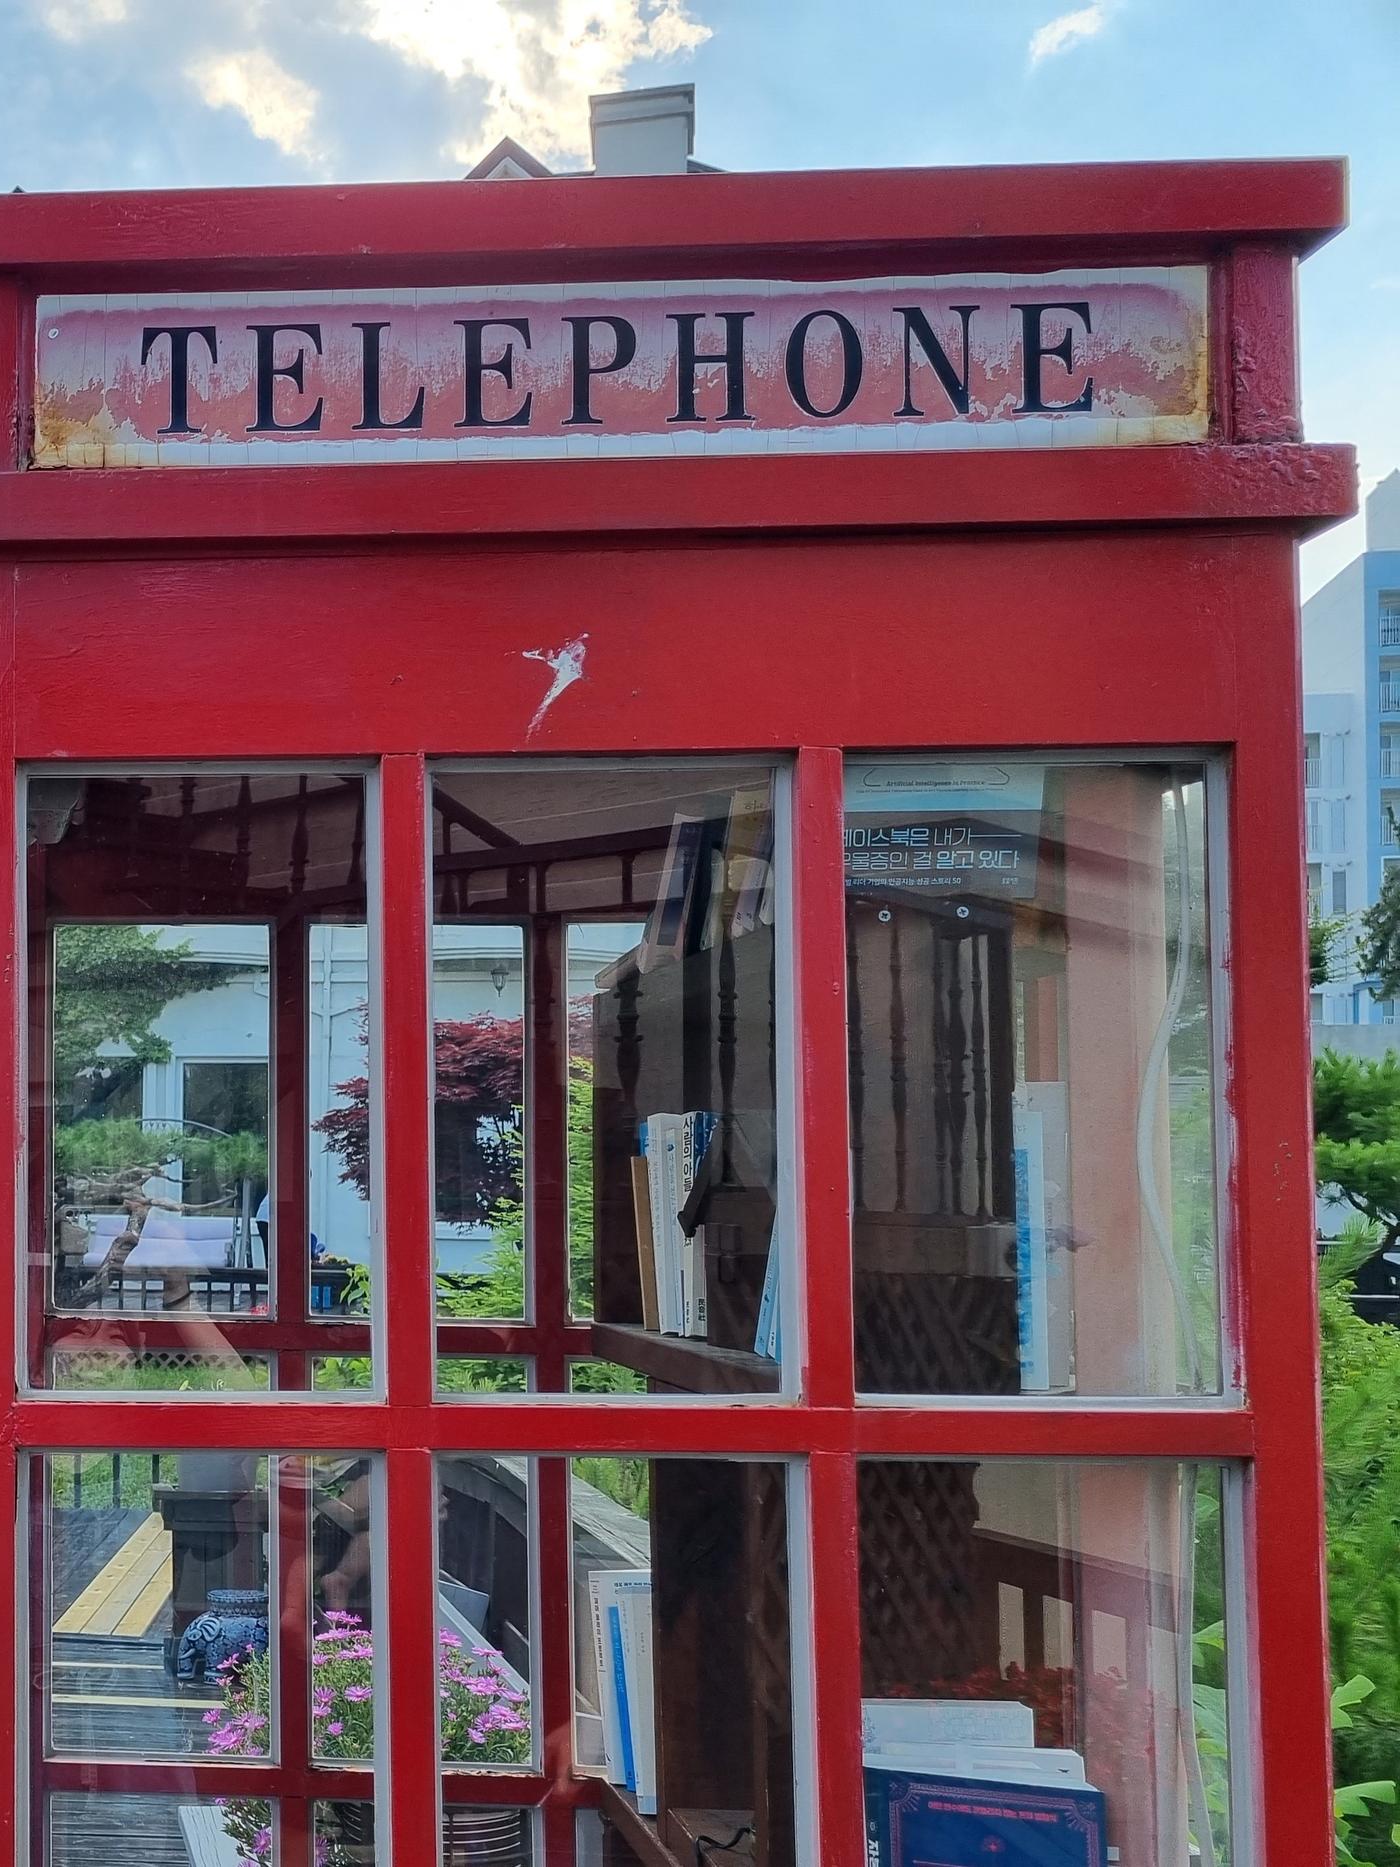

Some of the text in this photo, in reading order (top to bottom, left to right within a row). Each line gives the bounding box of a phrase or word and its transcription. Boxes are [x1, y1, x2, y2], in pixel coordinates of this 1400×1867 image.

[141, 302, 1093, 435] TELEPHONE
[913, 850, 932, 869] 걸
[936, 850, 974, 869] 알고
[978, 849, 1020, 869] 있다
[933, 827, 971, 846] 내가
[683, 1116, 693, 1193] 사람의 아들
